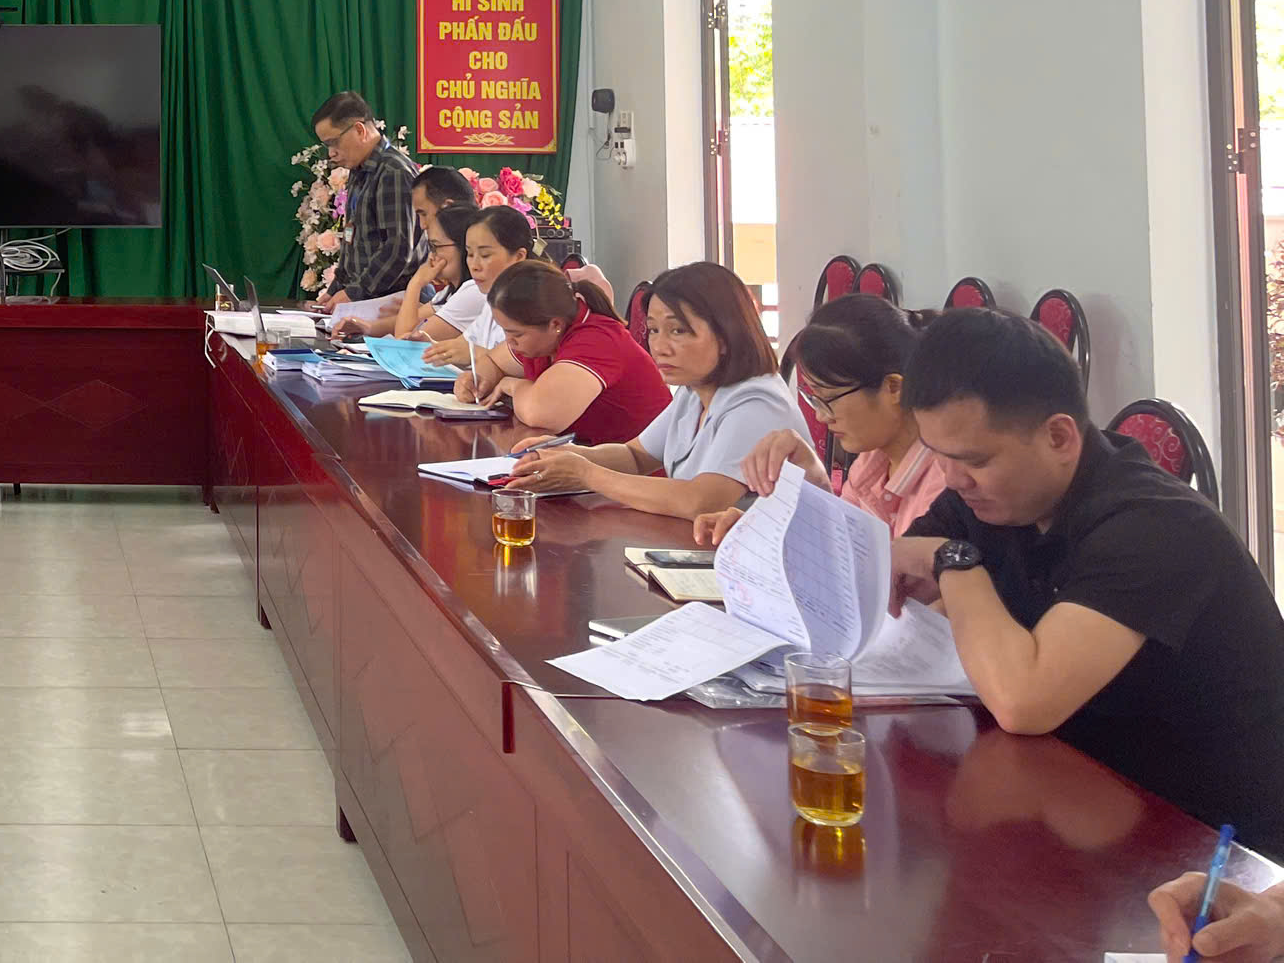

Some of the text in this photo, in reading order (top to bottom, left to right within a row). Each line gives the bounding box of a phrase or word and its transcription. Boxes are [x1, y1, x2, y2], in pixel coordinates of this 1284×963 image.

[439, 16, 538, 41] PHẤN ĐẤU
[469, 51, 508, 69] CHO
[436, 73, 541, 99] CHỦ NGHĨA
[439, 103, 539, 132] CỘNG SẢN
